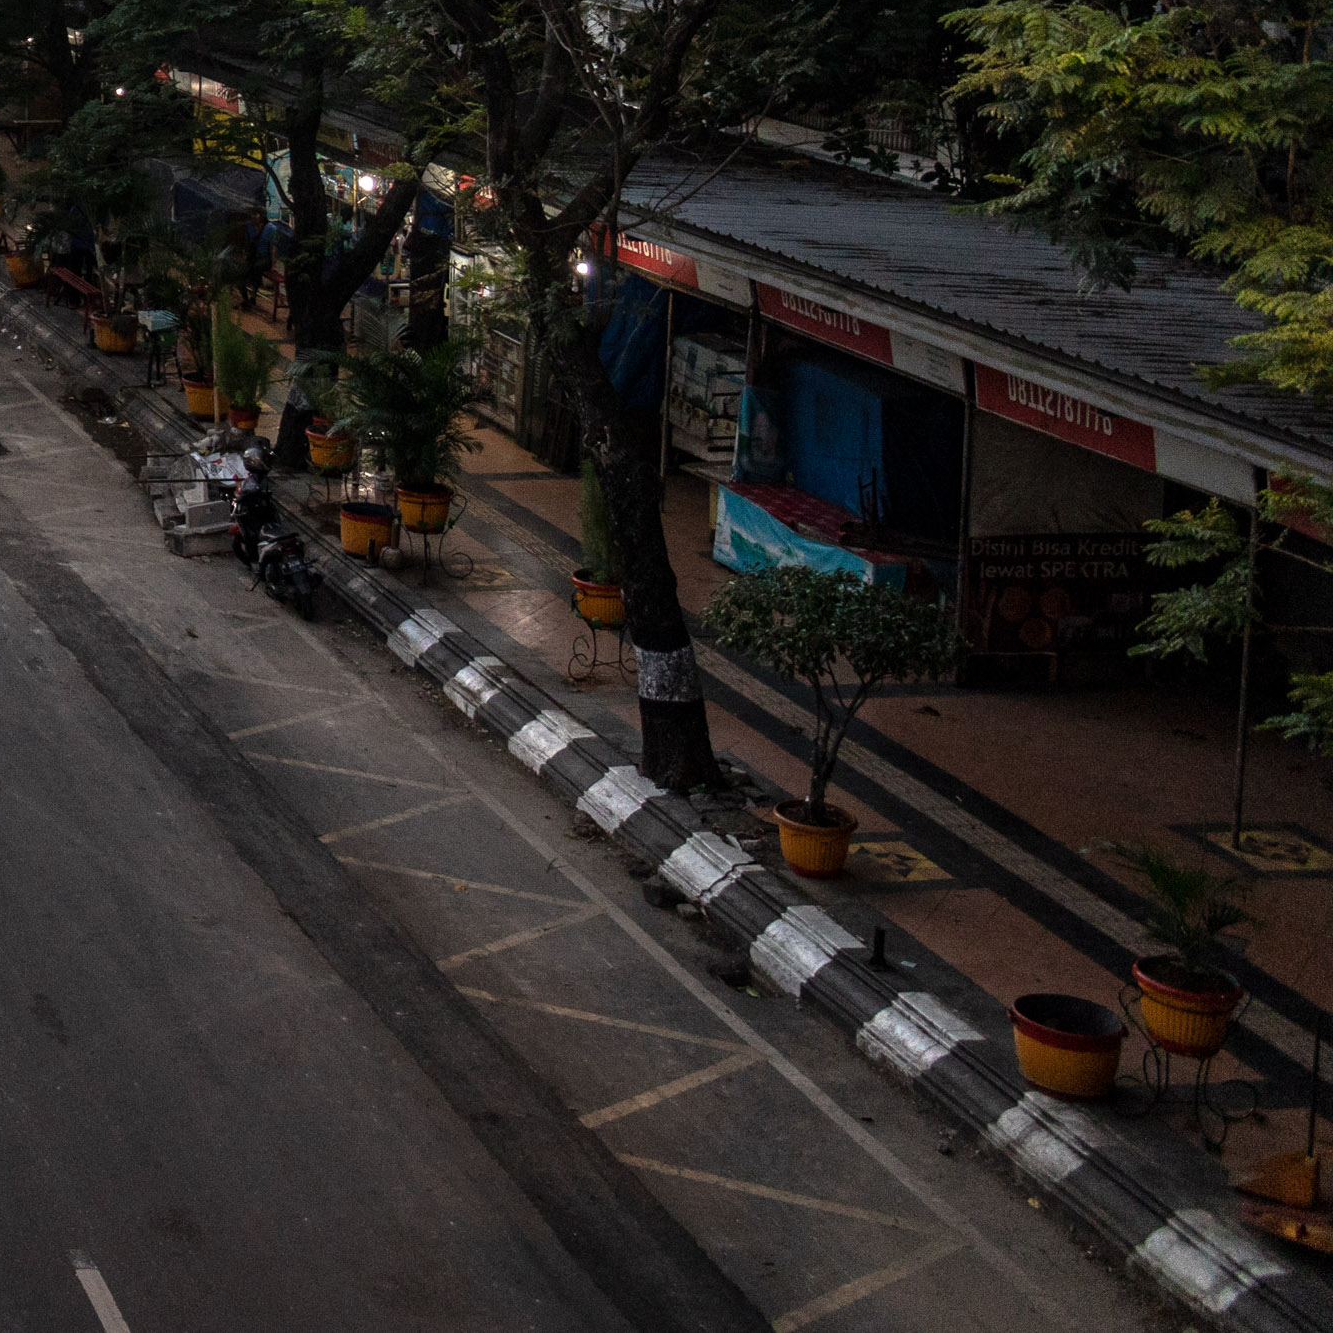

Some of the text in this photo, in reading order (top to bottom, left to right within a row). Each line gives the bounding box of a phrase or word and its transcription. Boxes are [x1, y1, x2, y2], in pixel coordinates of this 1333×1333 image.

[970, 538, 1025, 555] Disini
[1077, 538, 1139, 555] Kredit
[979, 561, 1034, 578] lewat
